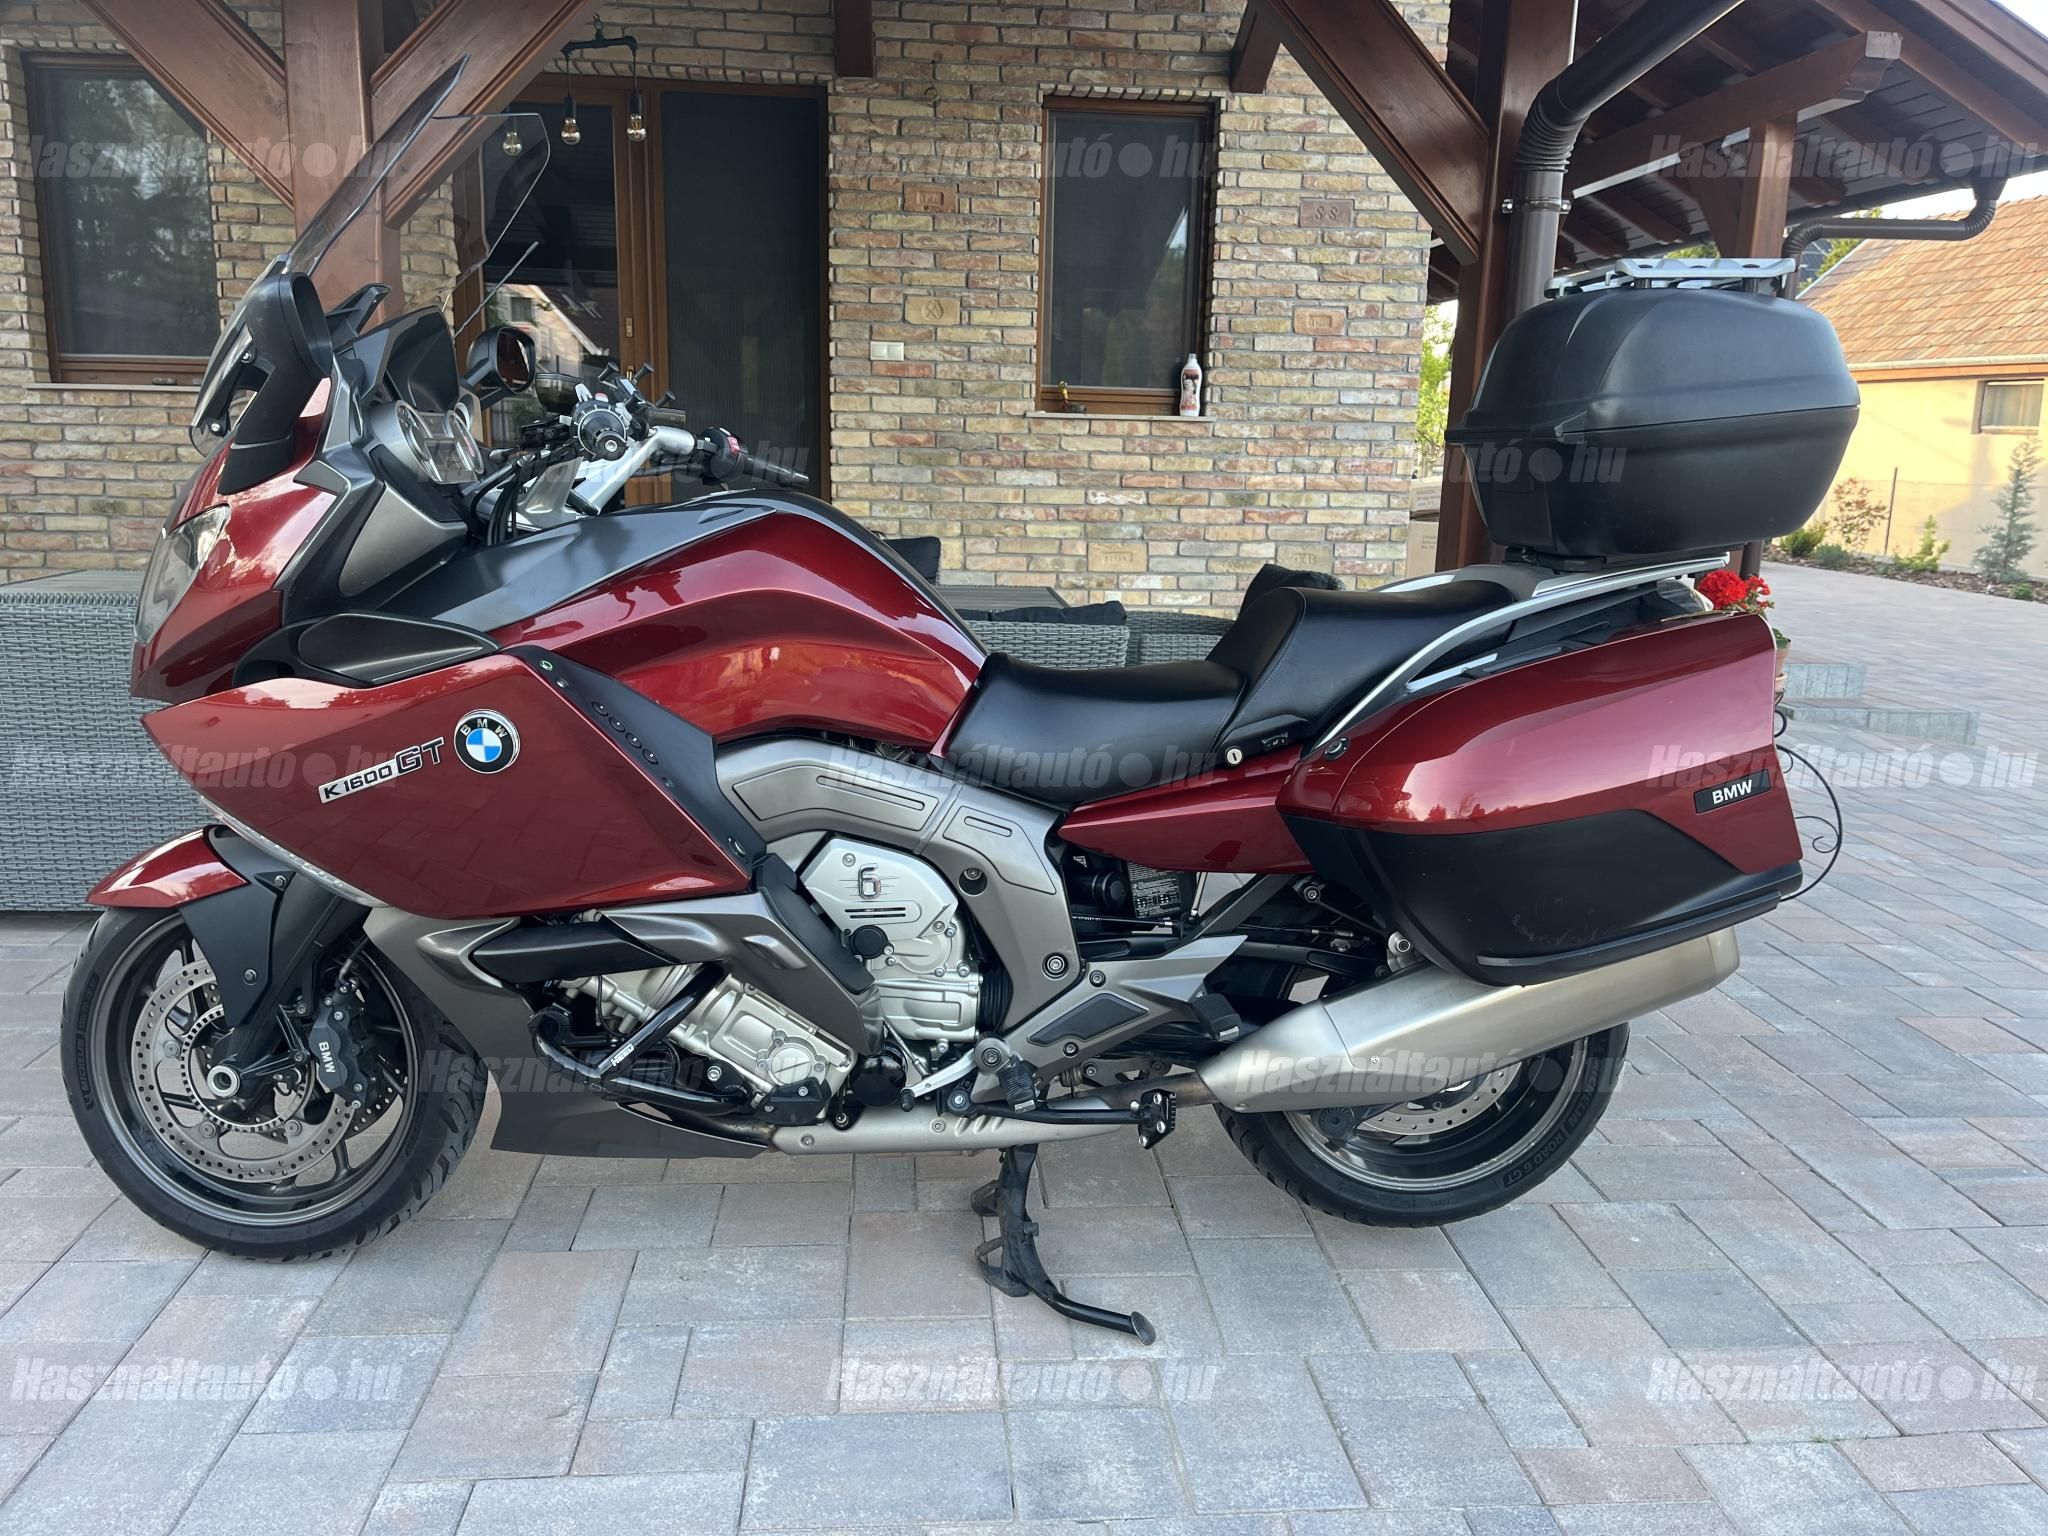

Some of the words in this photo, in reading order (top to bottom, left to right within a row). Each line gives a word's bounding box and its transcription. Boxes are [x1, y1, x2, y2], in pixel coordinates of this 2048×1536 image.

[460, 718, 508, 738] BMW
[1712, 779, 1752, 805] BMW
[858, 863, 881, 900] 6
[319, 1041, 336, 1073] BMW
[1534, 1132, 1564, 1162] ROAD
